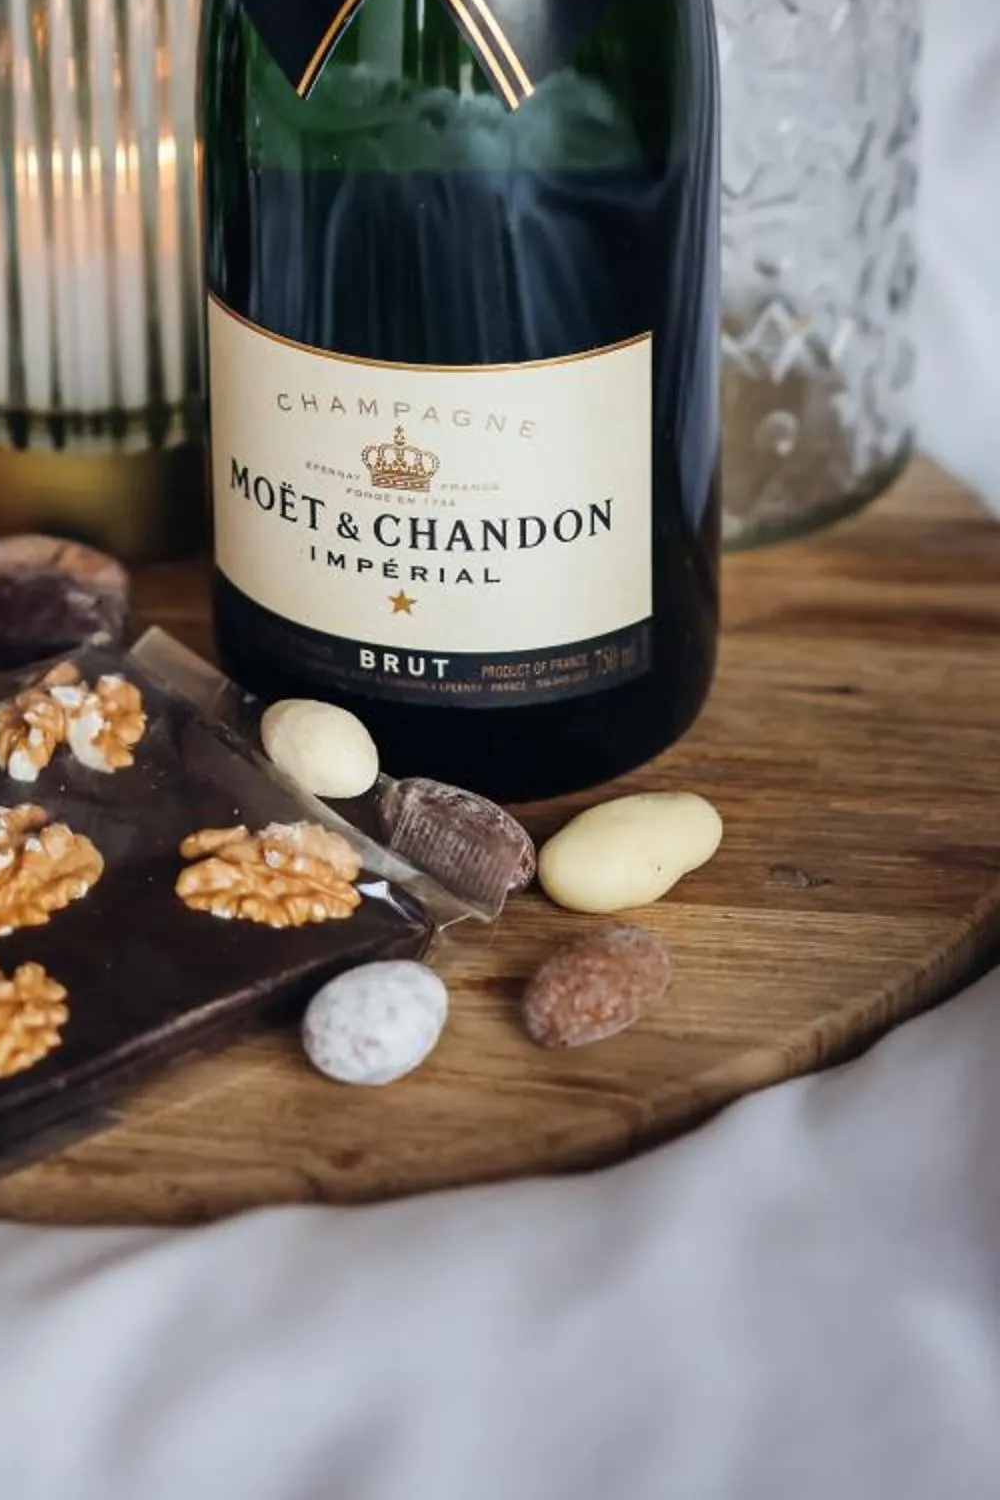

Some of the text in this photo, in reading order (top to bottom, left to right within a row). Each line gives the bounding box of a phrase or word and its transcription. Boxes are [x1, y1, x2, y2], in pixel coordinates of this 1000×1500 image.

[276, 392, 537, 440] CHAMPAGNE
[230, 457, 614, 552] MOËT & CHANDON
[310, 545, 502, 584] IMPÉRIAL
[359, 649, 450, 679] BRUT
[481, 663, 531, 680] PRODUCT
[533, 661, 547, 675] OF
